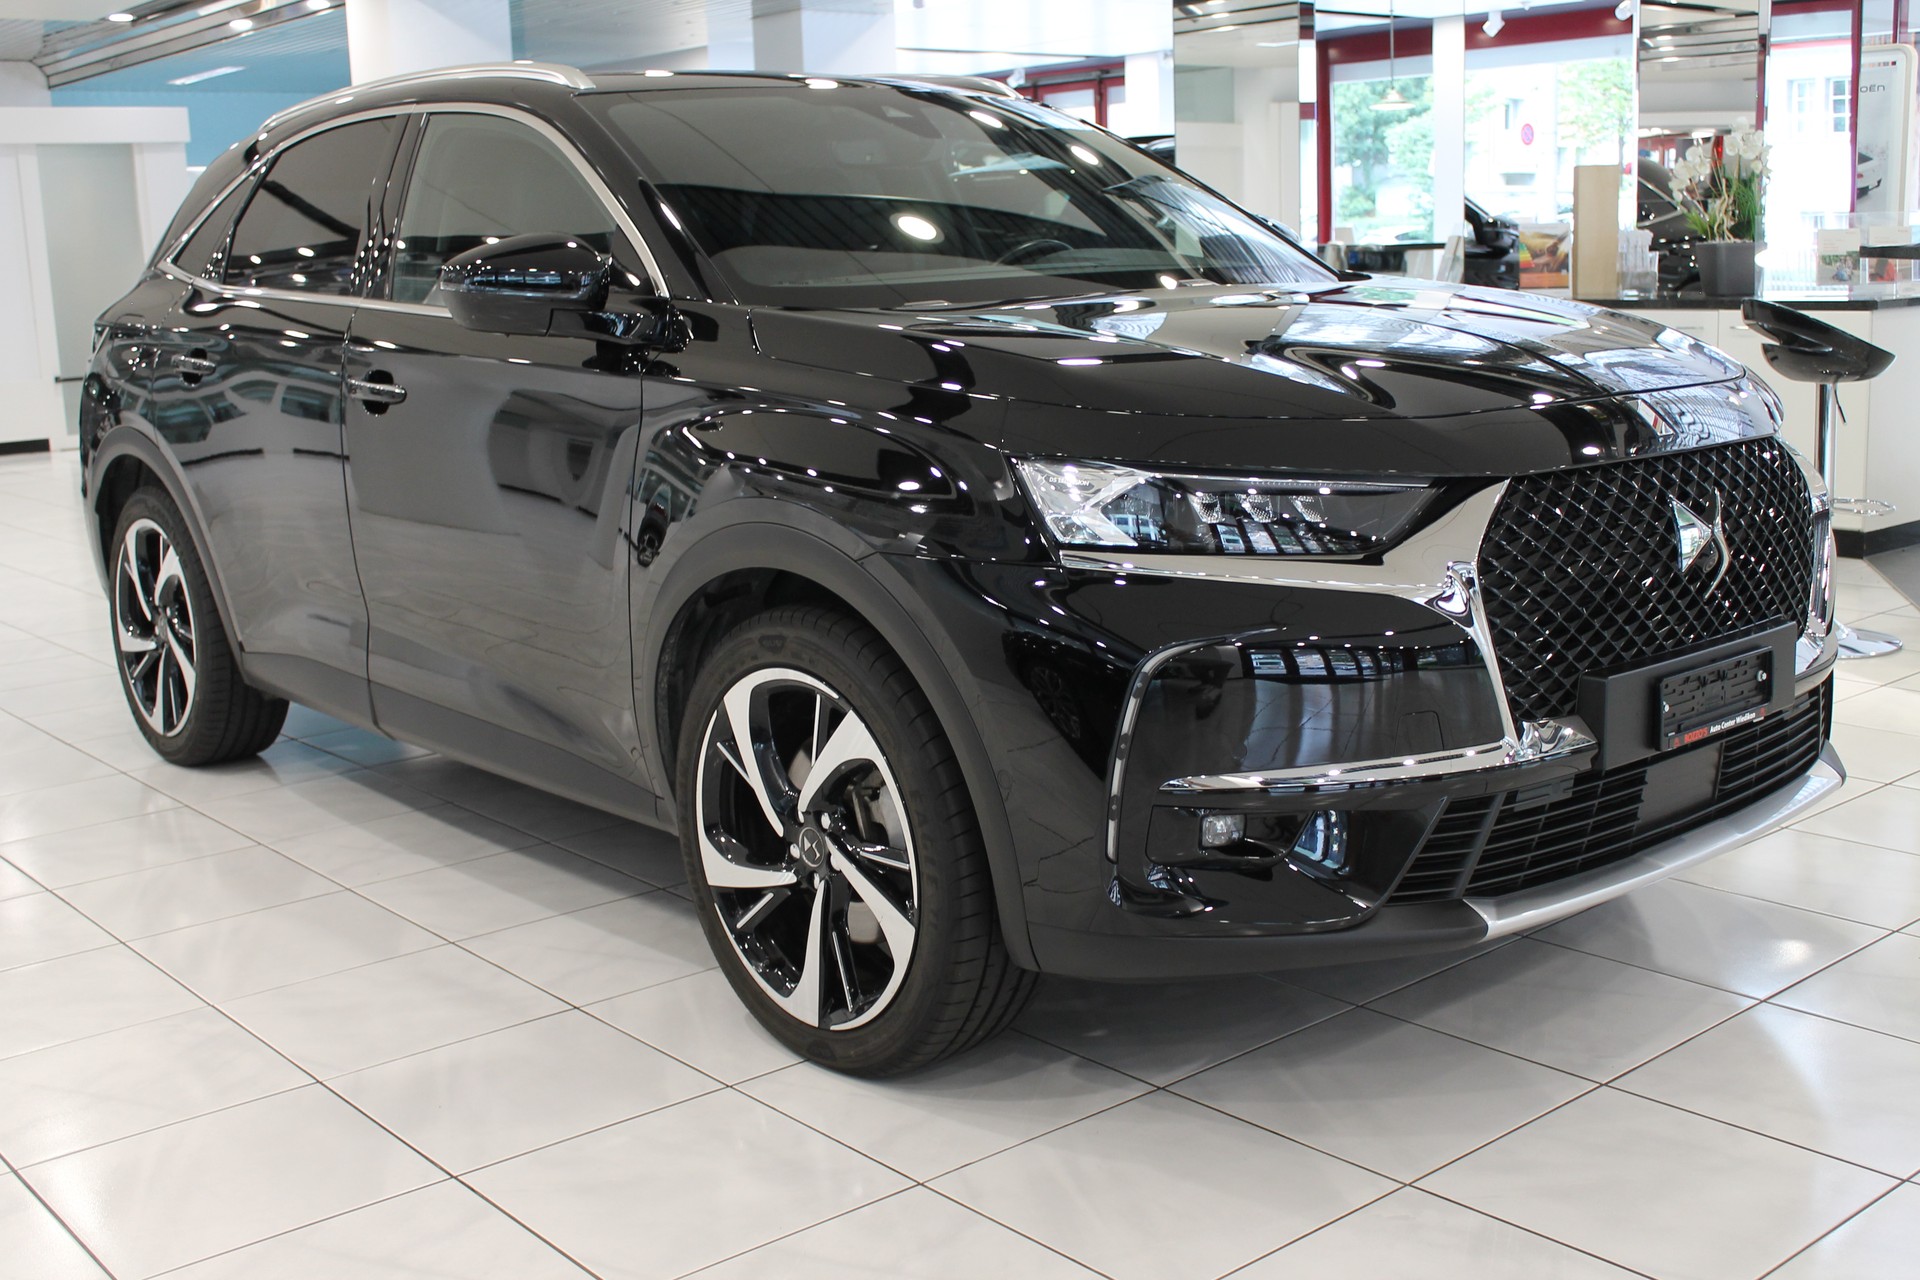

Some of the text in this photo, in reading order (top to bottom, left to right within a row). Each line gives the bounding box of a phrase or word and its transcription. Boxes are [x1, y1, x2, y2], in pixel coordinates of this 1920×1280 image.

[1710, 725, 1721, 734] Auto
[1721, 719, 1735, 730] Center
[1735, 712, 1756, 724] Wiedikon
